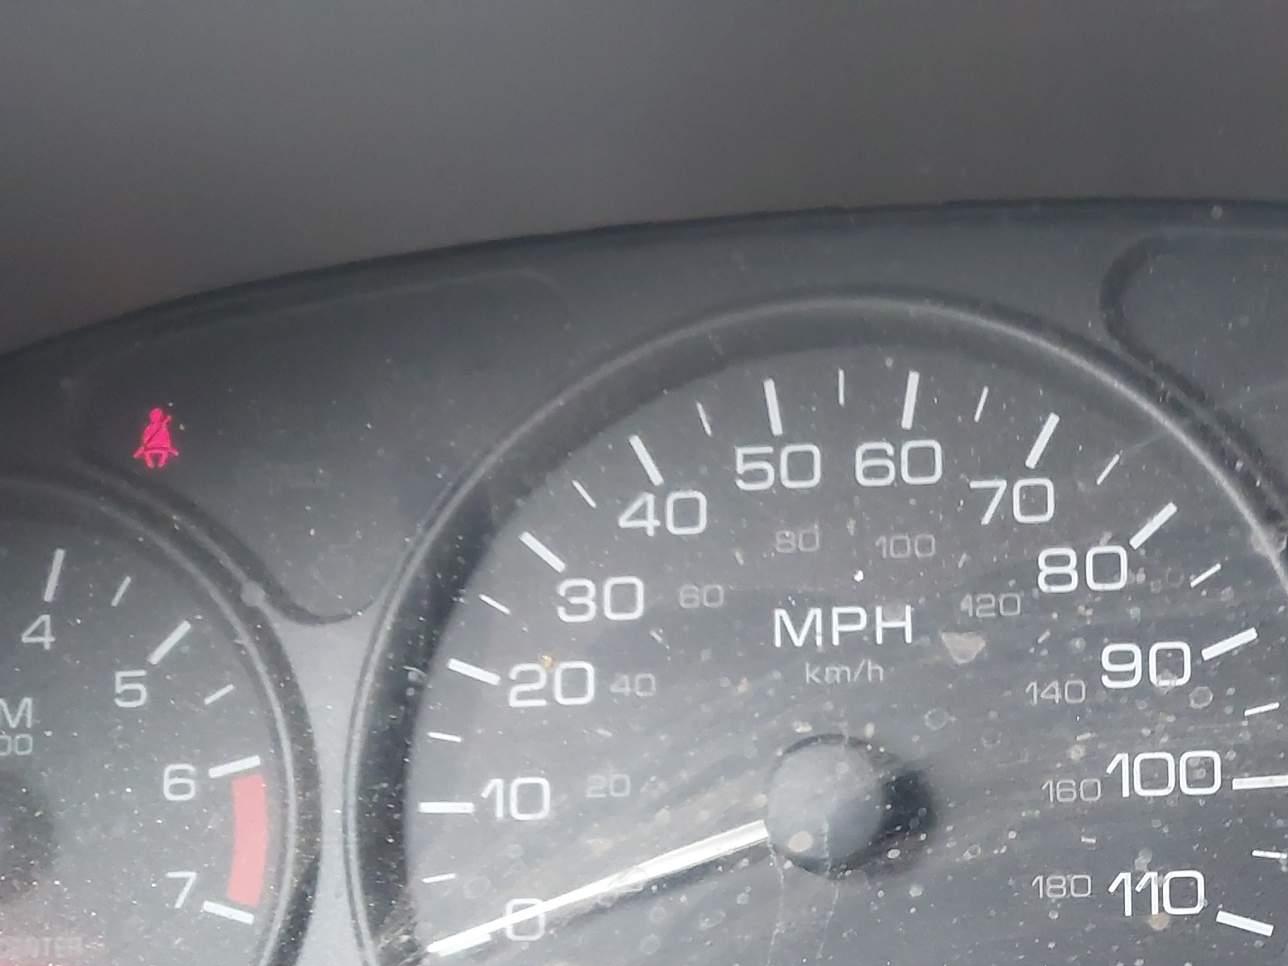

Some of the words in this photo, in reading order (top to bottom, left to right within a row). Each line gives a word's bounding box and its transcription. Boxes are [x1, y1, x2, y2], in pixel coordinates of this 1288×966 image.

[735, 444, 822, 490] 50
[855, 439, 943, 487] 60
[618, 490, 708, 536] 40
[969, 477, 1054, 523] 70
[775, 526, 820, 553] 80
[875, 533, 936, 559] 100
[1038, 545, 1128, 593] 80
[556, 575, 645, 623] 30
[679, 584, 724, 609] 60
[960, 594, 1021, 618] 120
[21, 614, 55, 650] 4
[774, 605, 913, 648] MPH
[805, 658, 885, 684] km/h
[1101, 641, 1191, 688] 90
[115, 670, 147, 708] 5
[508, 661, 596, 707] 20
[609, 673, 656, 698] 40
[1025, 679, 1086, 705] 140
[162, 765, 195, 800] 6
[586, 772, 631, 799] 20
[1041, 778, 1100, 802] 160
[1105, 750, 1222, 798] 100
[481, 777, 551, 821] 10
[166, 871, 196, 908] 7
[1031, 874, 1092, 899] 180
[1108, 869, 1206, 917] 110
[506, 898, 545, 941] 0
